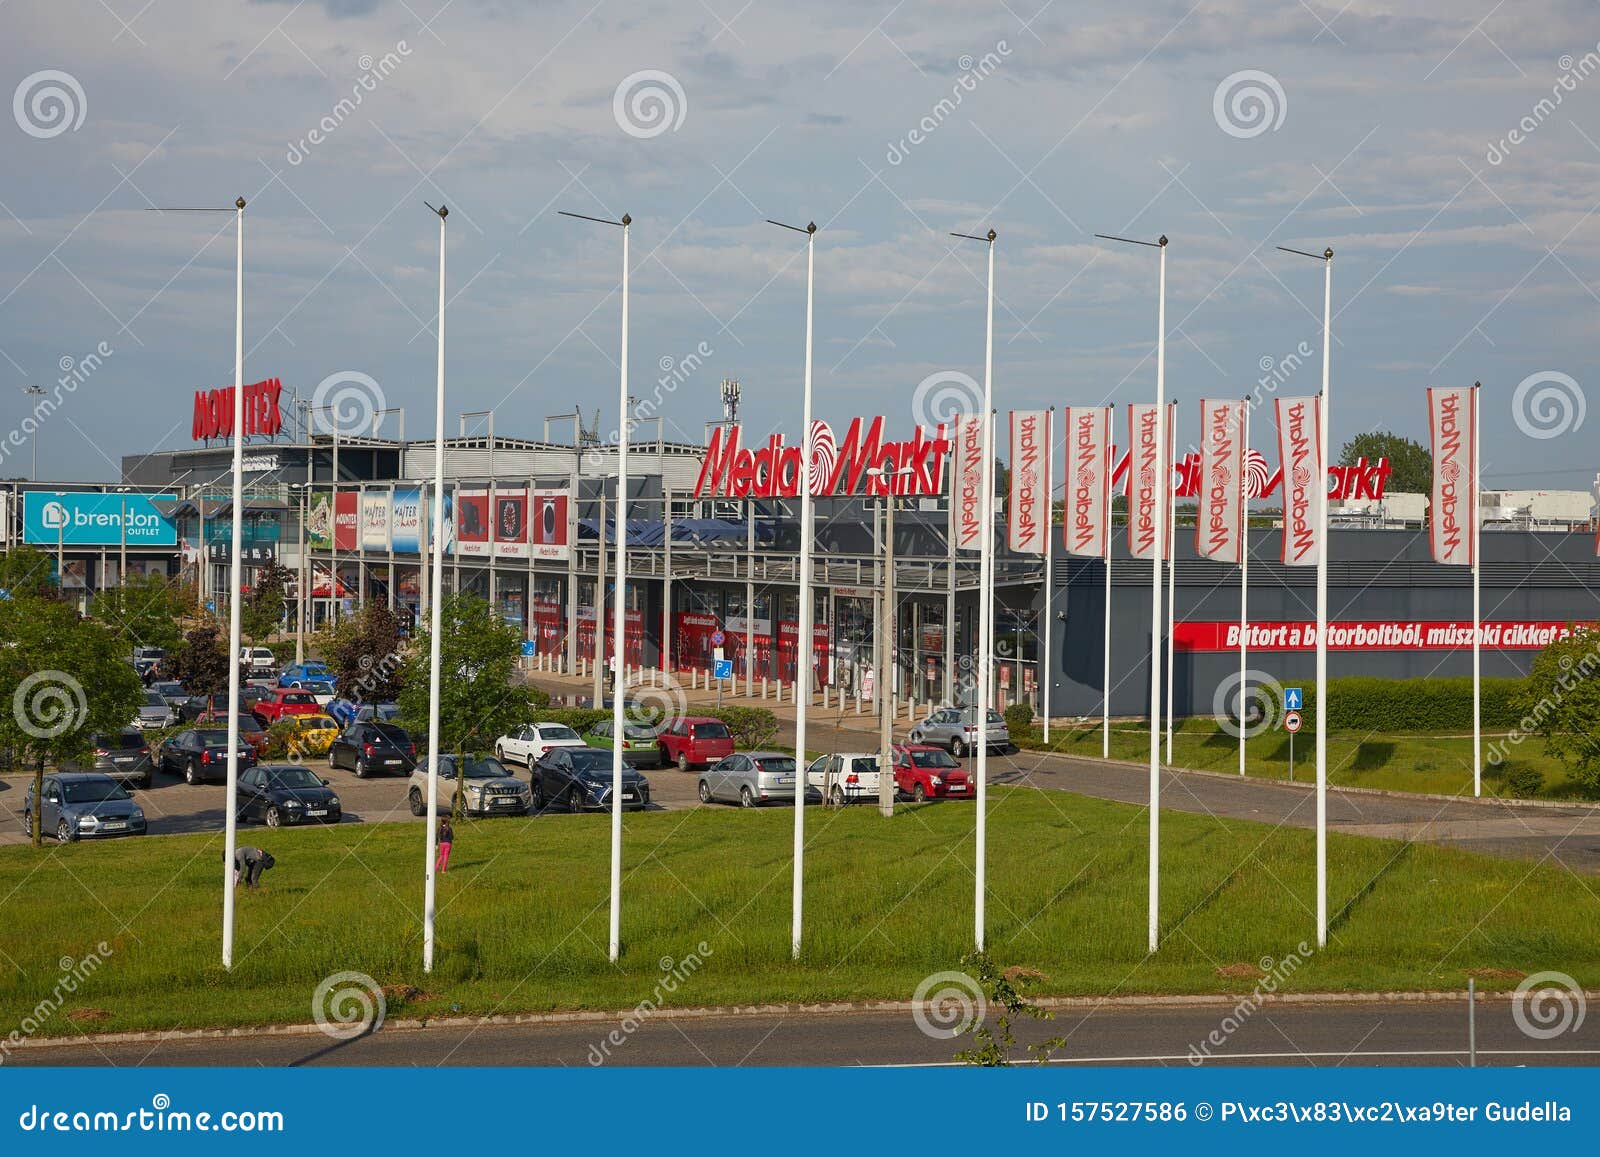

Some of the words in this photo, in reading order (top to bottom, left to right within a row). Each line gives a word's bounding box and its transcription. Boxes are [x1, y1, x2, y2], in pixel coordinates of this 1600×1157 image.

[693, 425, 803, 499] Media
[823, 416, 953, 497] Markt
[75, 507, 159, 527] brendon
[128, 528, 160, 536] OUTLET
[1289, 628, 1301, 646] a
[1503, 624, 1557, 646] cikket
